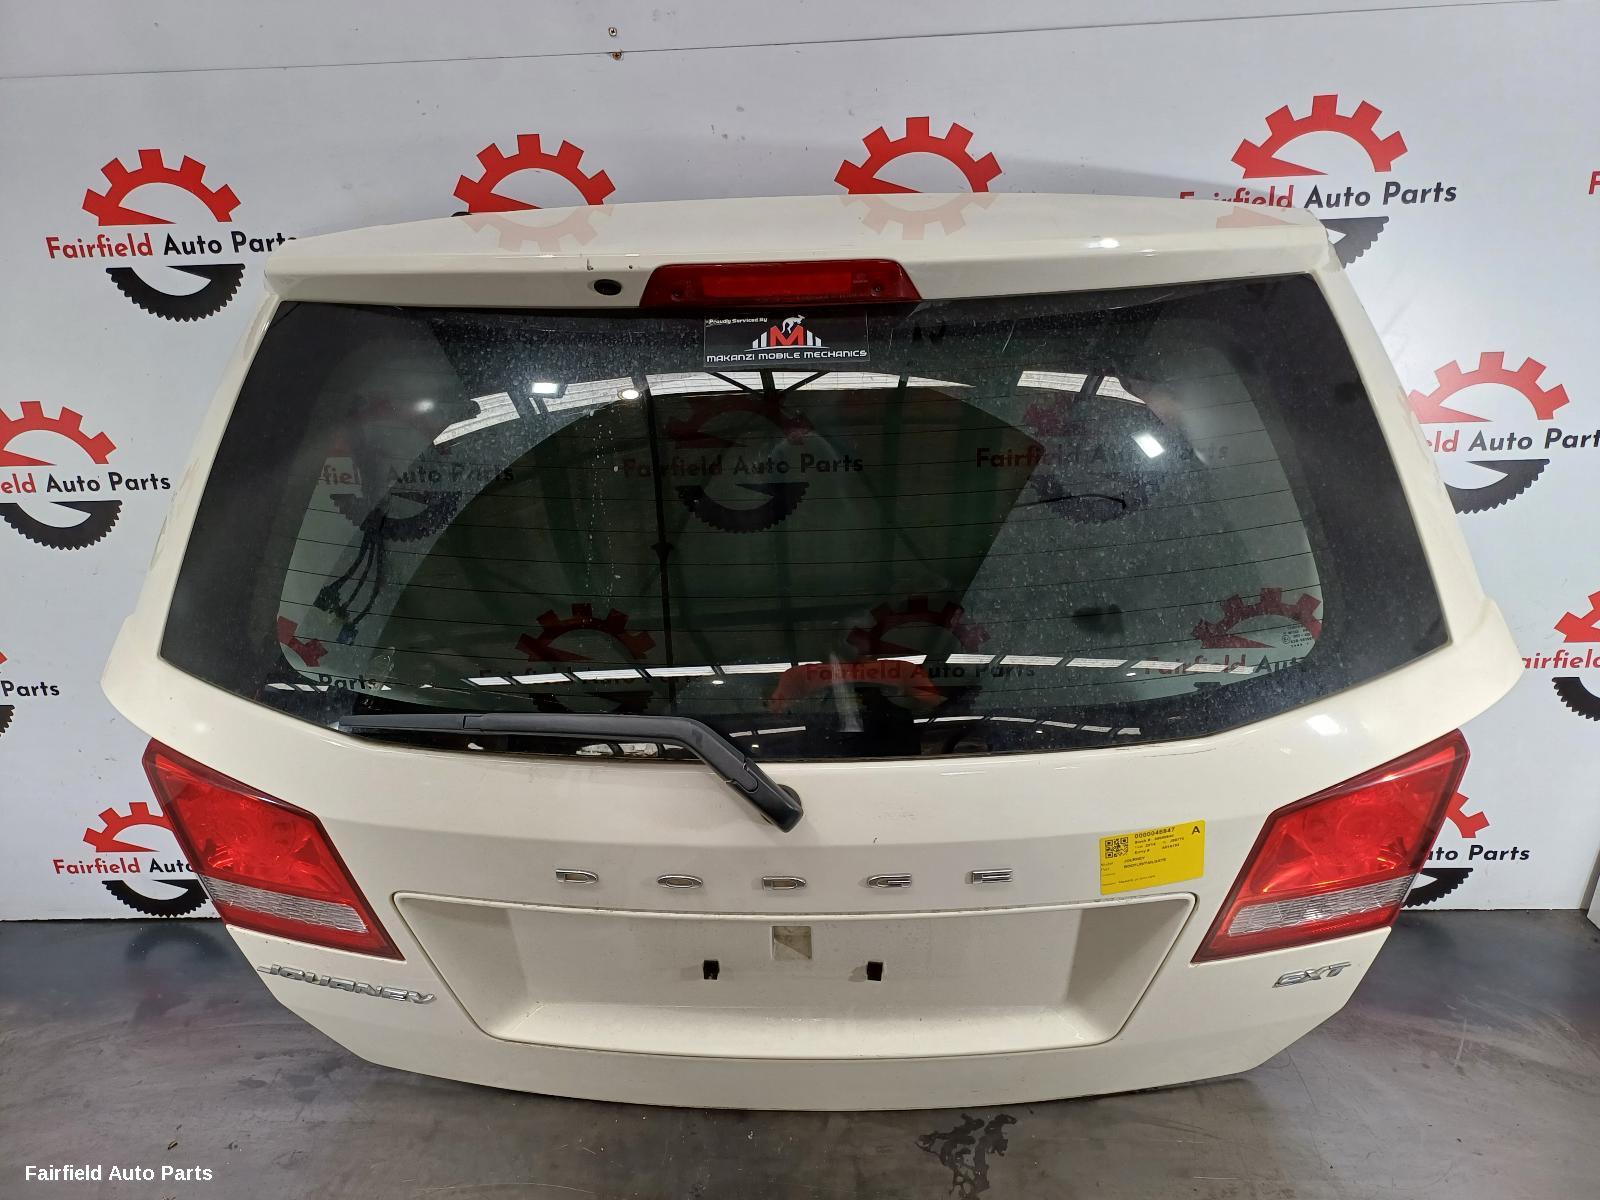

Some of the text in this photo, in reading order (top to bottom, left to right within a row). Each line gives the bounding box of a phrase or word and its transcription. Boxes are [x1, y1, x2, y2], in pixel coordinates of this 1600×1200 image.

[1304, 185, 1371, 208] Auto
[1382, 181, 1457, 205] Parts
[46, 231, 297, 259] Fairfield Auto Part
[706, 350, 867, 363] MAKANZI MOBILE MECHANICS
[1468, 429, 1532, 452] Auto
[1544, 428, 1600, 449] Part
[801, 453, 863, 473] Parts
[47, 473, 100, 493] Auto
[108, 472, 171, 491] Parts
[911, 664, 965, 680] Auto
[0, 680, 60, 697] Parts
[1191, 826, 1200, 834] A
[1468, 844, 1531, 861] Parts
[52, 857, 141, 874] Fairfield
[555, 867, 1014, 889] DODGE
[256, 963, 436, 1004] JOURNEY
